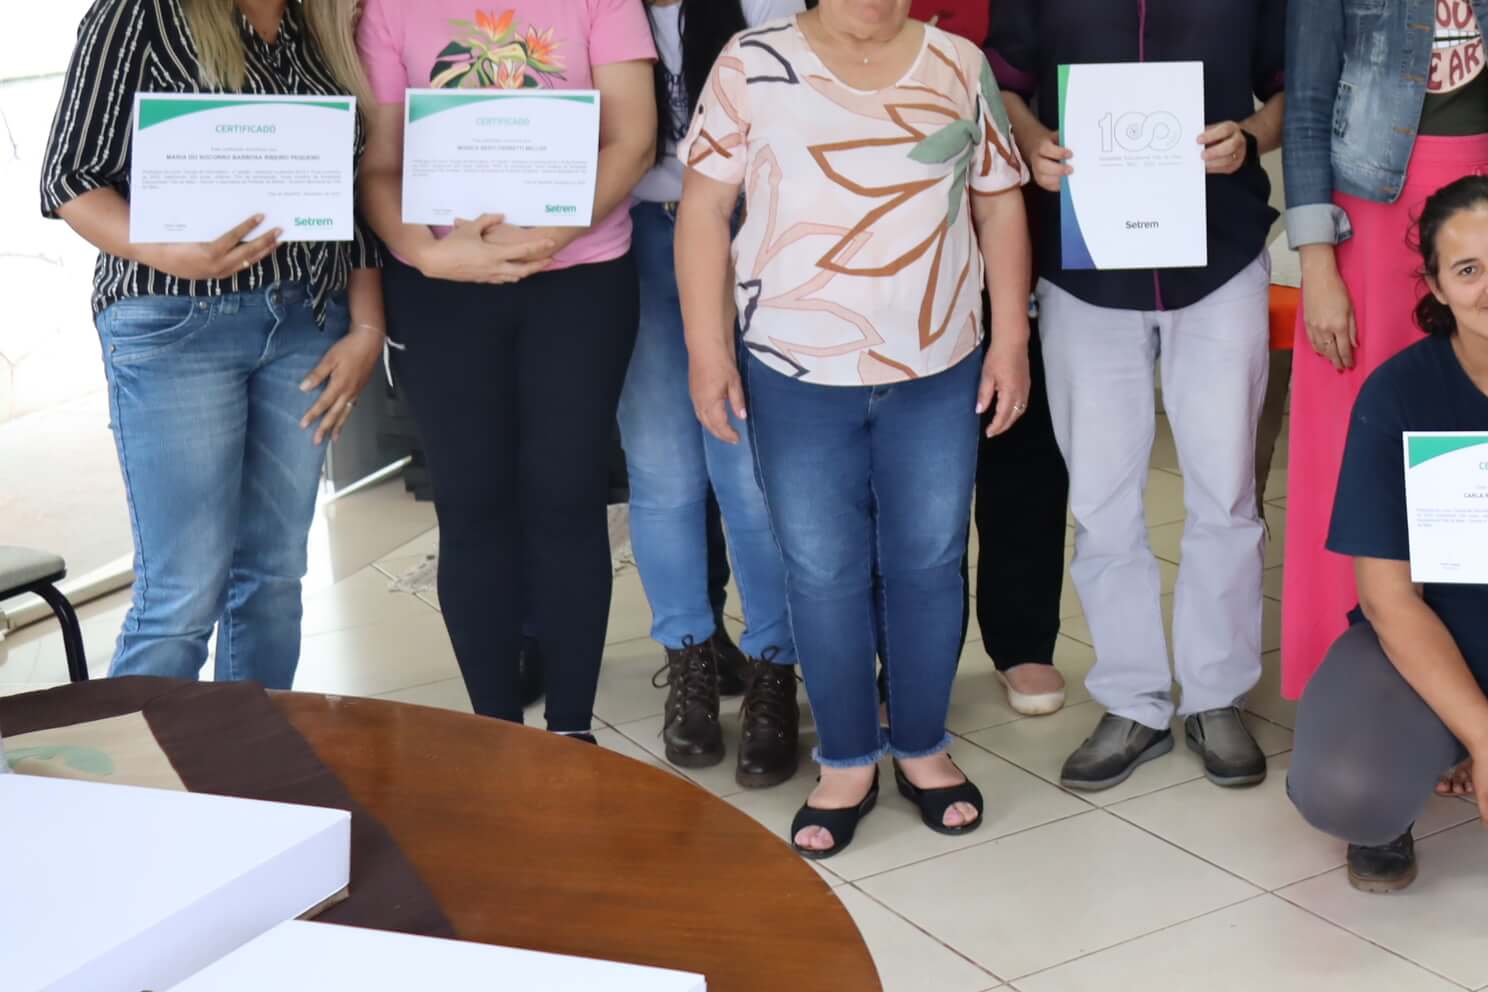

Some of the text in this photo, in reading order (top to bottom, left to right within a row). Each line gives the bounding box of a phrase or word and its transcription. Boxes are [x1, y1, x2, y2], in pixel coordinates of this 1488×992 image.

[475, 117, 531, 127] CERTIFICADO
[215, 124, 277, 134] CERTIFICADO
[1098, 110, 1184, 153] 100
[545, 204, 577, 213] Setrem
[294, 217, 334, 227] Setrem
[1124, 219, 1160, 230] Setrem
